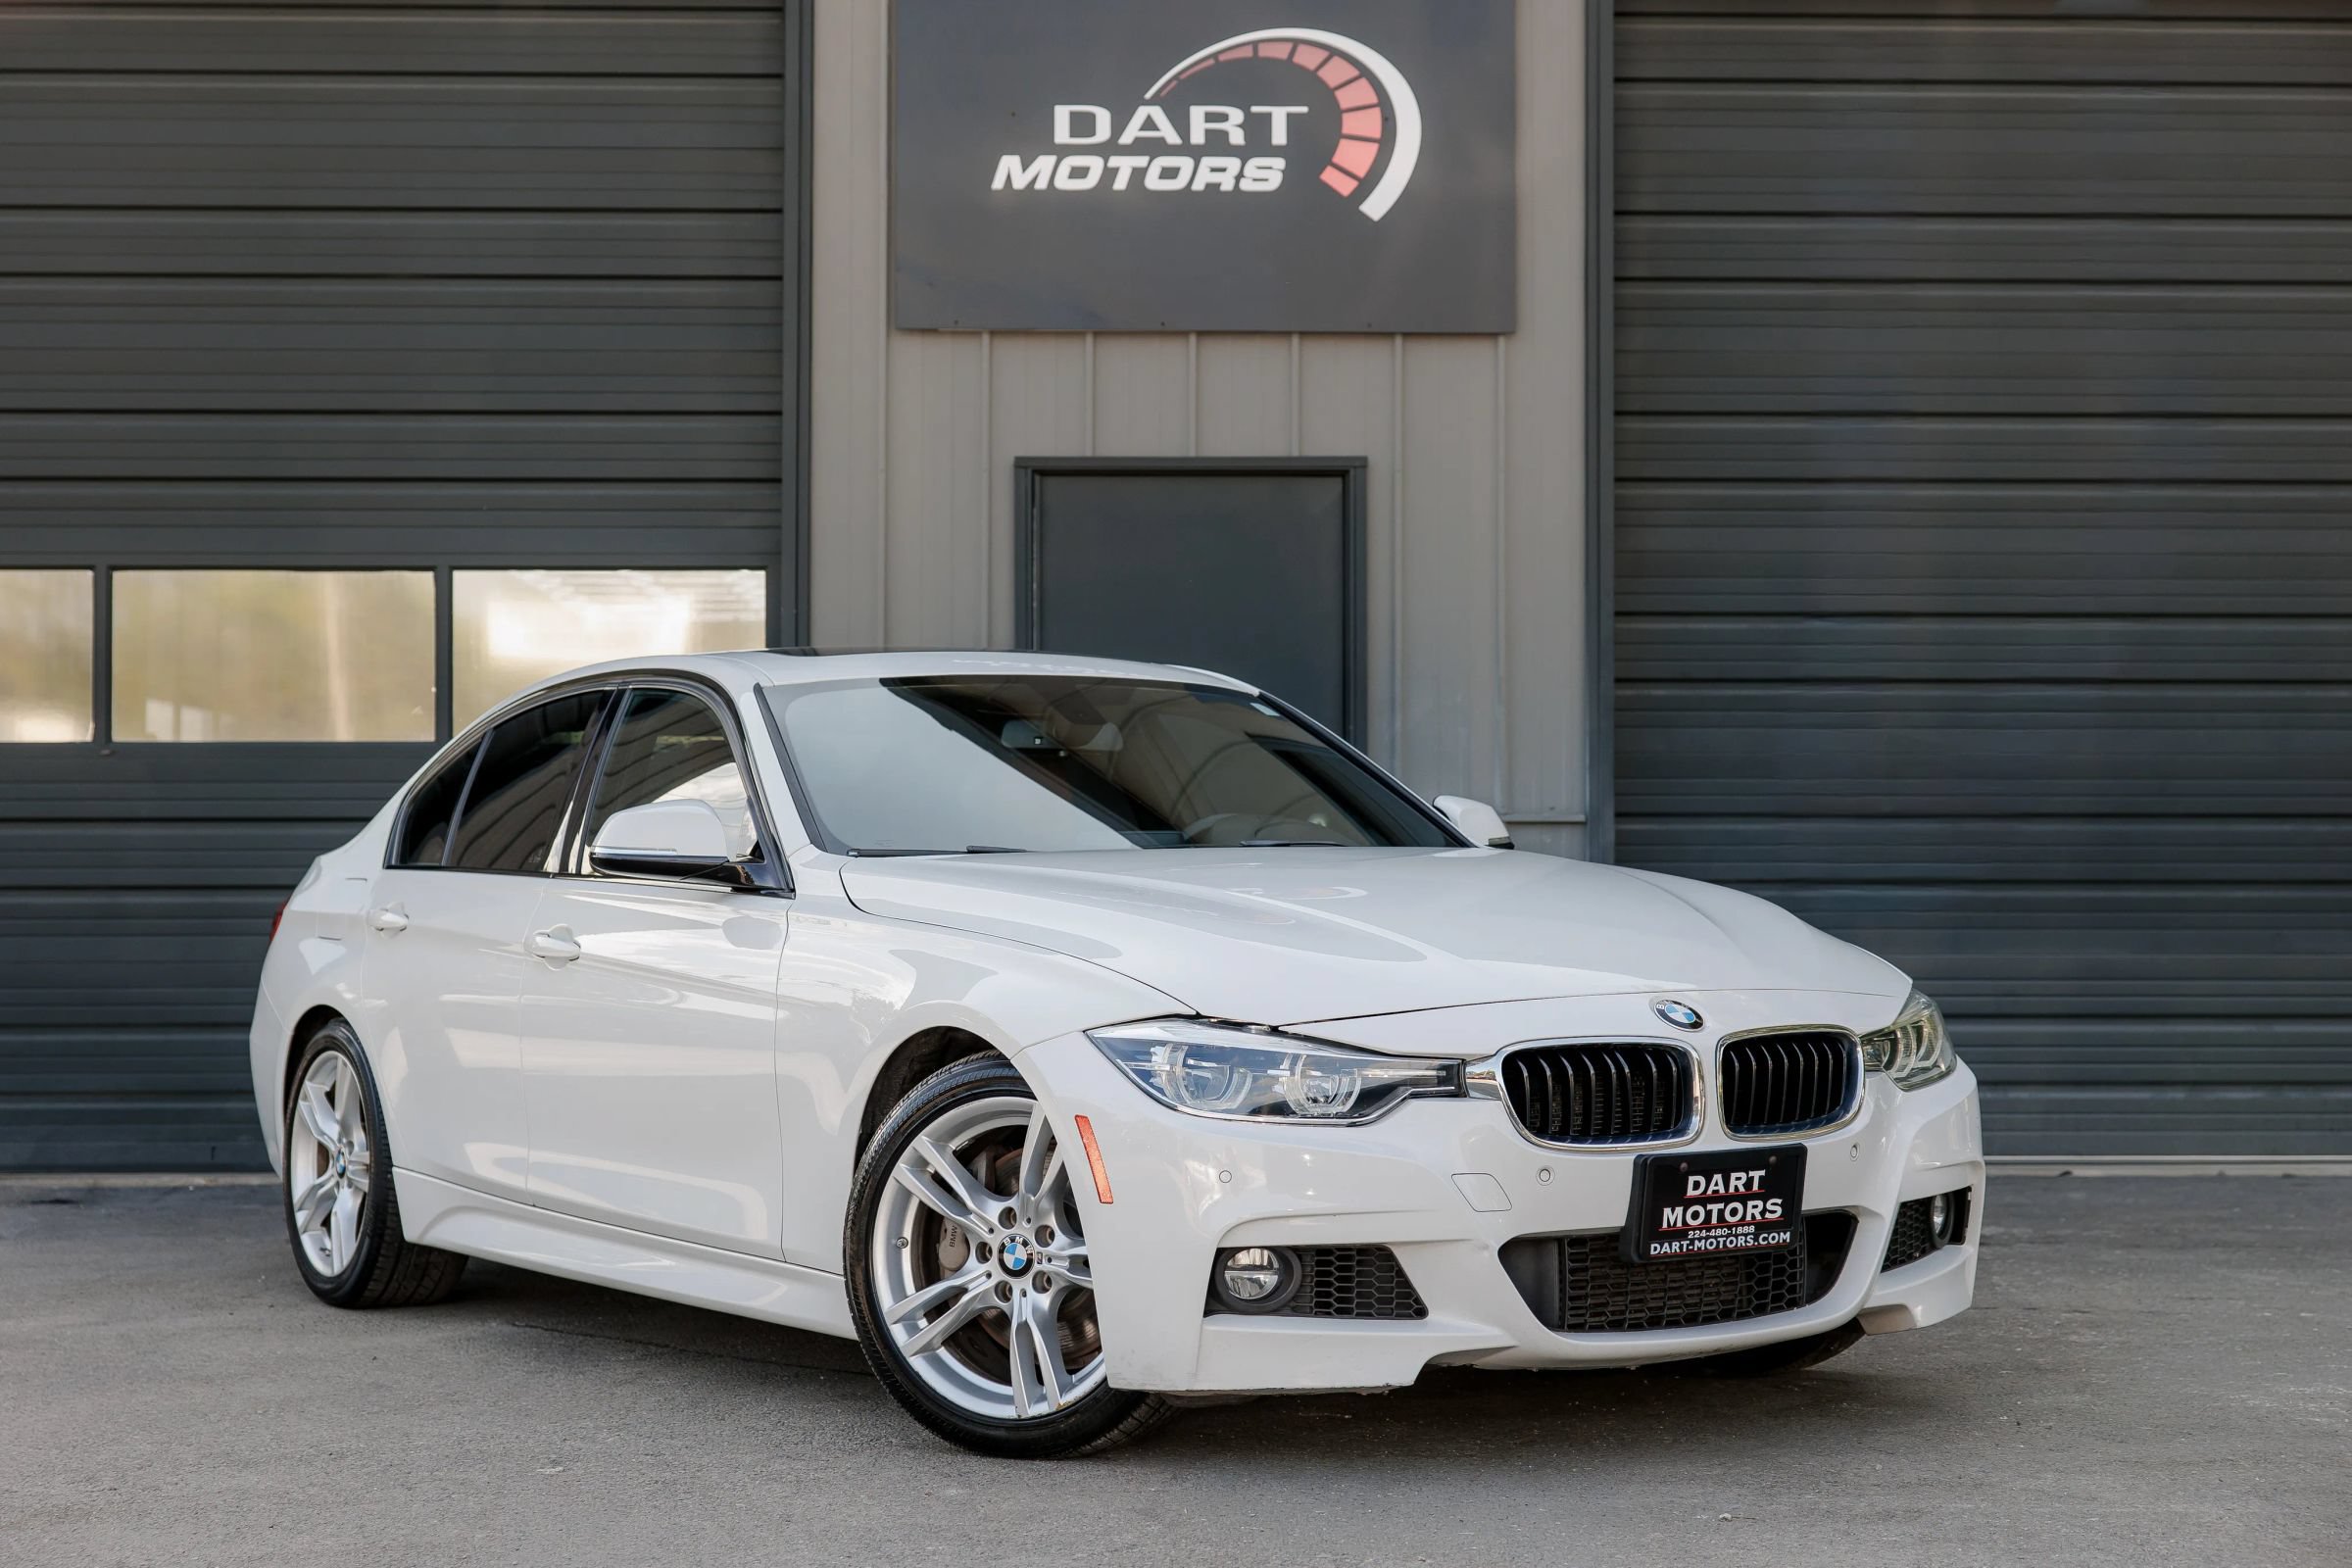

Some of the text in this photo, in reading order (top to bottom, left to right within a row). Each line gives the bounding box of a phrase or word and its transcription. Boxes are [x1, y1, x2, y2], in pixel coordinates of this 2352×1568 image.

[1054, 104, 1309, 146] DART
[990, 154, 1287, 192] MOTORS
[1686, 1169, 1766, 1197] DART
[1662, 1199, 1784, 1229] MOTORS
[1649, 1231, 1790, 1255] DART-MOTORS.COM
[1688, 1225, 1755, 1239] 224-480-1888
